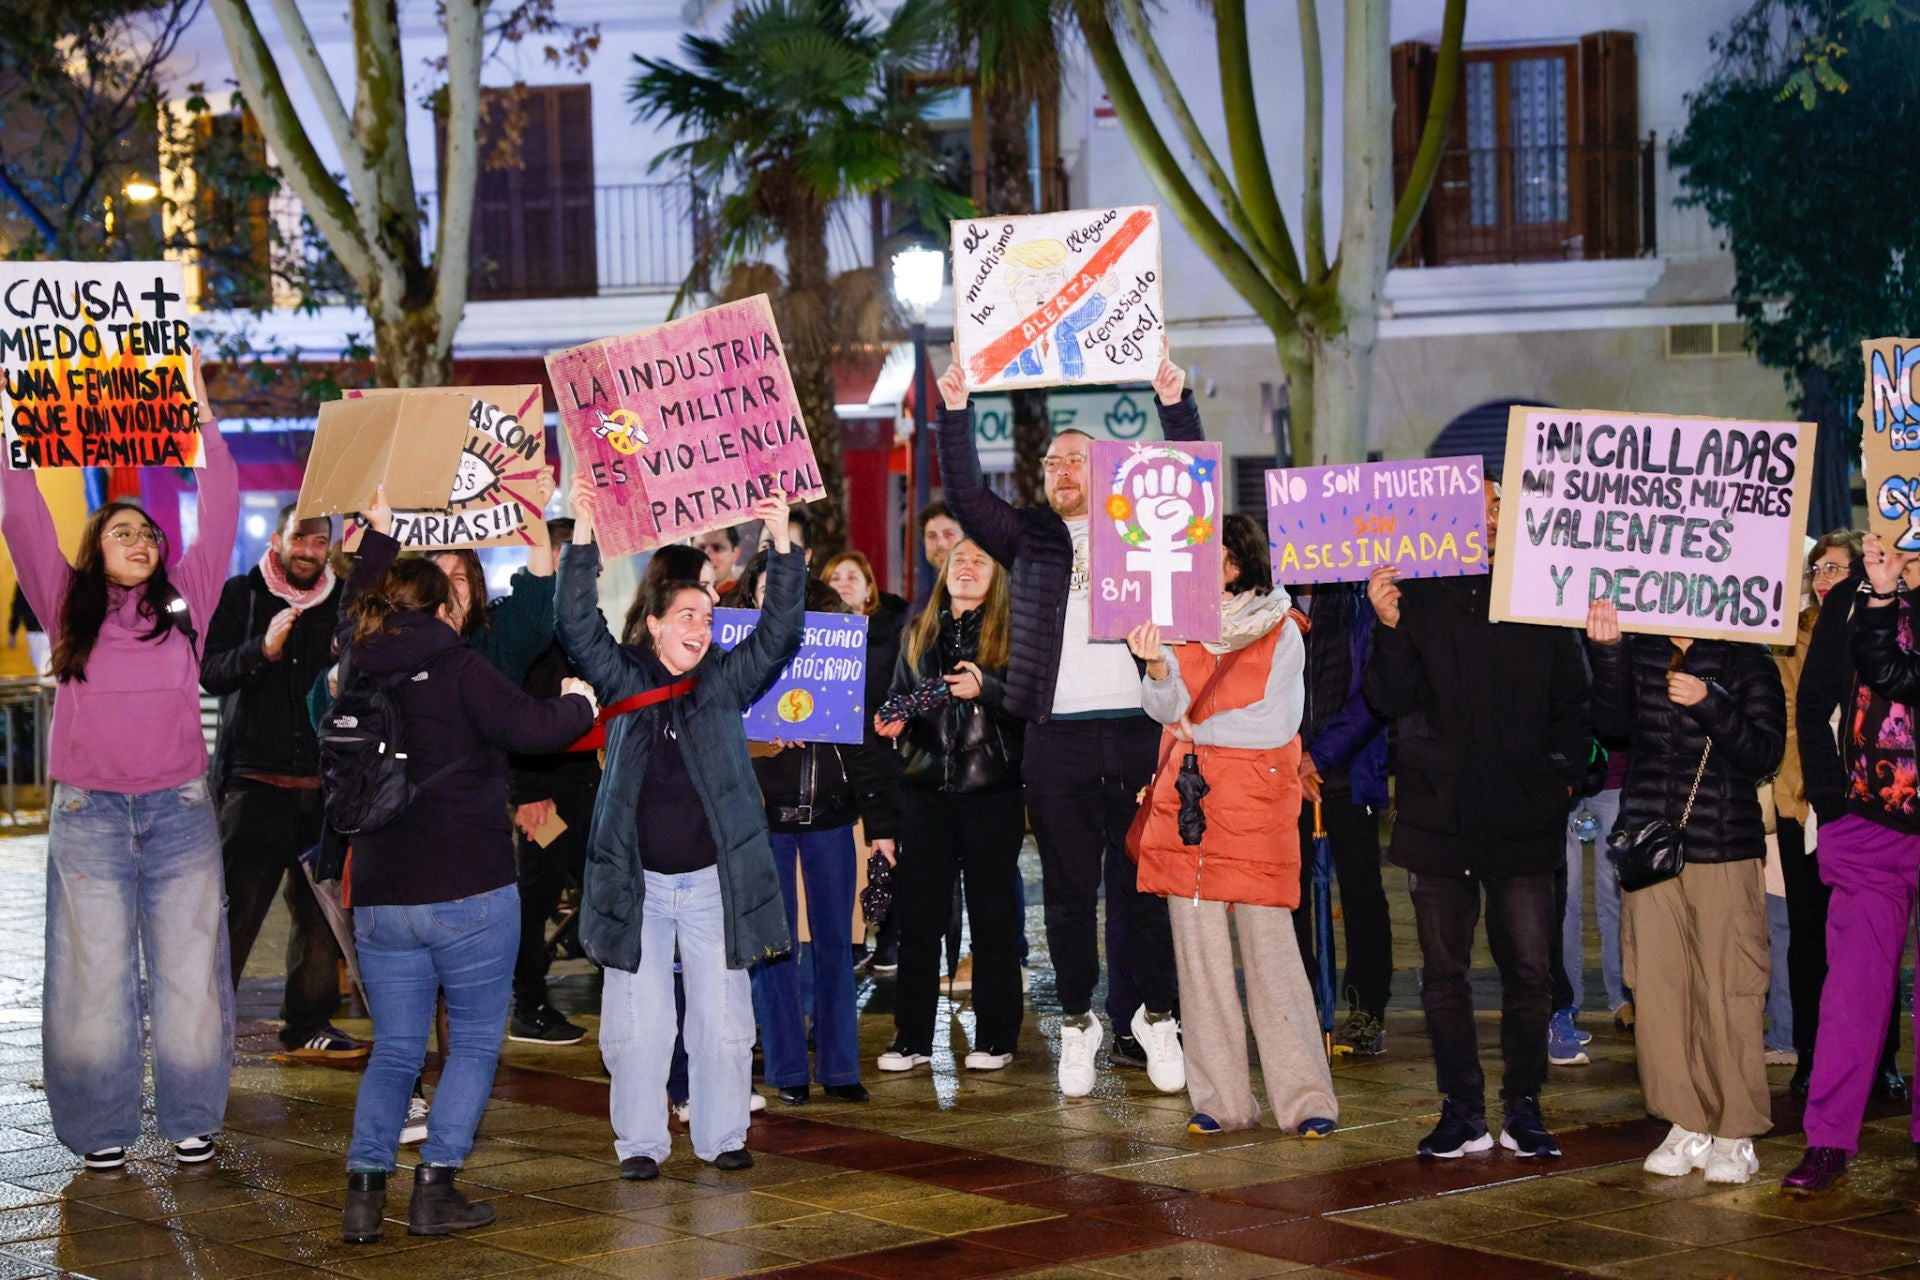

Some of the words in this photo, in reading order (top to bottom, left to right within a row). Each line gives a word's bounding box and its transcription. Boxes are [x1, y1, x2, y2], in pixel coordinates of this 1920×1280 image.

[963, 223, 989, 254] el
[966, 223, 1015, 304] machismo
[4, 277, 134, 321] CAUSA
[141, 277, 180, 319] +
[970, 303, 995, 326] ha
[1022, 273, 1096, 342] ALERTA
[1084, 271, 1156, 350] demasiado
[0, 324, 101, 363] MIEDO
[107, 320, 192, 356] TENER
[4, 367, 60, 401] UNA
[66, 367, 191, 405] FEMINISTA
[568, 376, 609, 411] LA
[617, 332, 780, 397] INDUSTRIA
[11, 405, 71, 438] QUE
[111, 401, 200, 435] VIOLADOR
[658, 375, 780, 431] MILITAR
[81, 435, 185, 468] FAMILIA
[591, 460, 629, 488] ES
[642, 415, 806, 478] VIOLENCIA
[1587, 424, 1797, 486] CALLADAS
[650, 463, 822, 533] PATRIARCAL
[1268, 470, 1308, 507] NO
[1322, 466, 1360, 499] SON
[1374, 464, 1481, 500] MUERTAS
[1522, 468, 1555, 499] NI
[1563, 469, 1687, 515] SUMISAS,
[1690, 478, 1793, 522] MUJERES
[1353, 516, 1396, 536] SON
[1525, 507, 1734, 563] VALIENTES
[1279, 531, 1483, 572] ASESINADAS
[1101, 577, 1141, 603] 8M
[1550, 564, 1573, 606] Y
[1588, 566, 1783, 628] DECIDIDAS!
